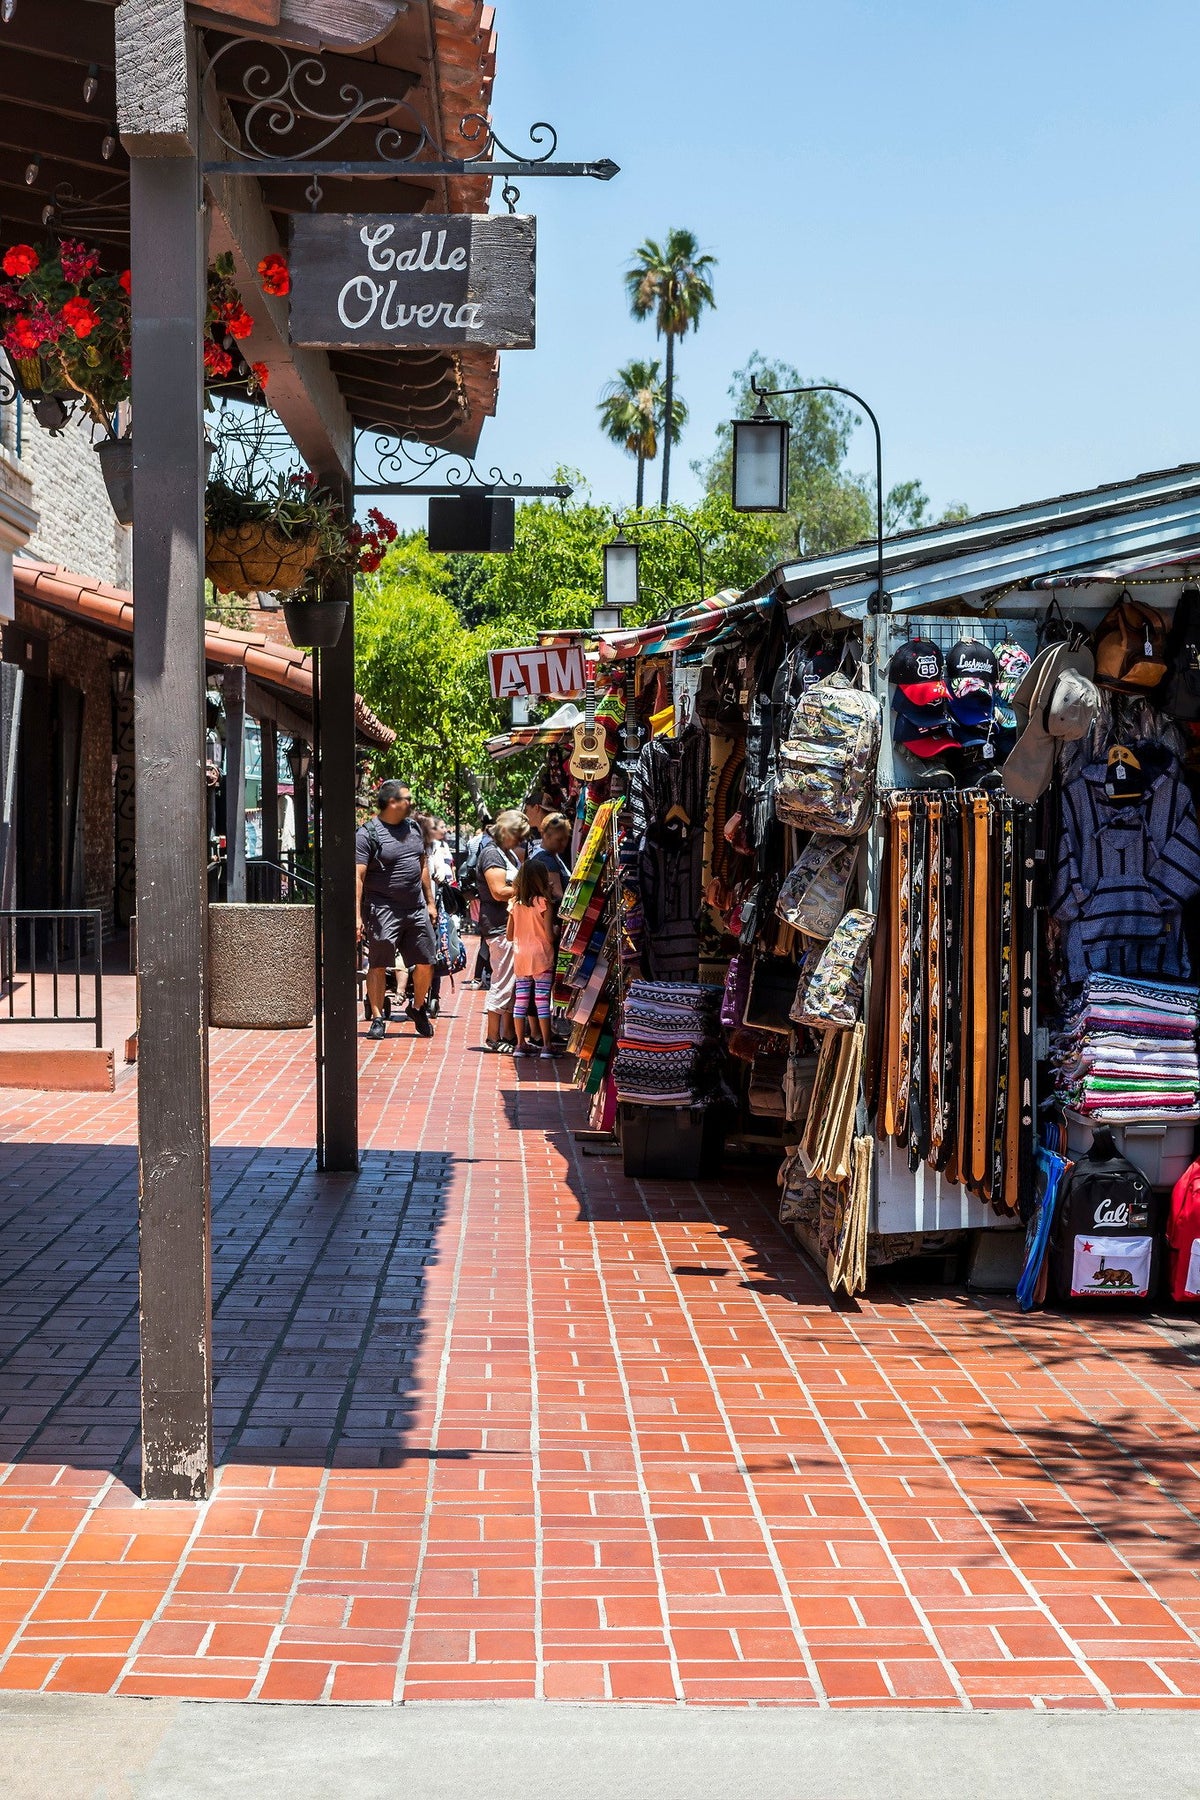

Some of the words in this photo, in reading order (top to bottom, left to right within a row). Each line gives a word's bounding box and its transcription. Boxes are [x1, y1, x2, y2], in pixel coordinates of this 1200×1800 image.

[360, 223, 467, 271] Calle
[338, 275, 484, 330] Olvera
[499, 648, 583, 697] ATM
[841, 949, 855, 959] 66
[1093, 1199, 1129, 1228] Cali
